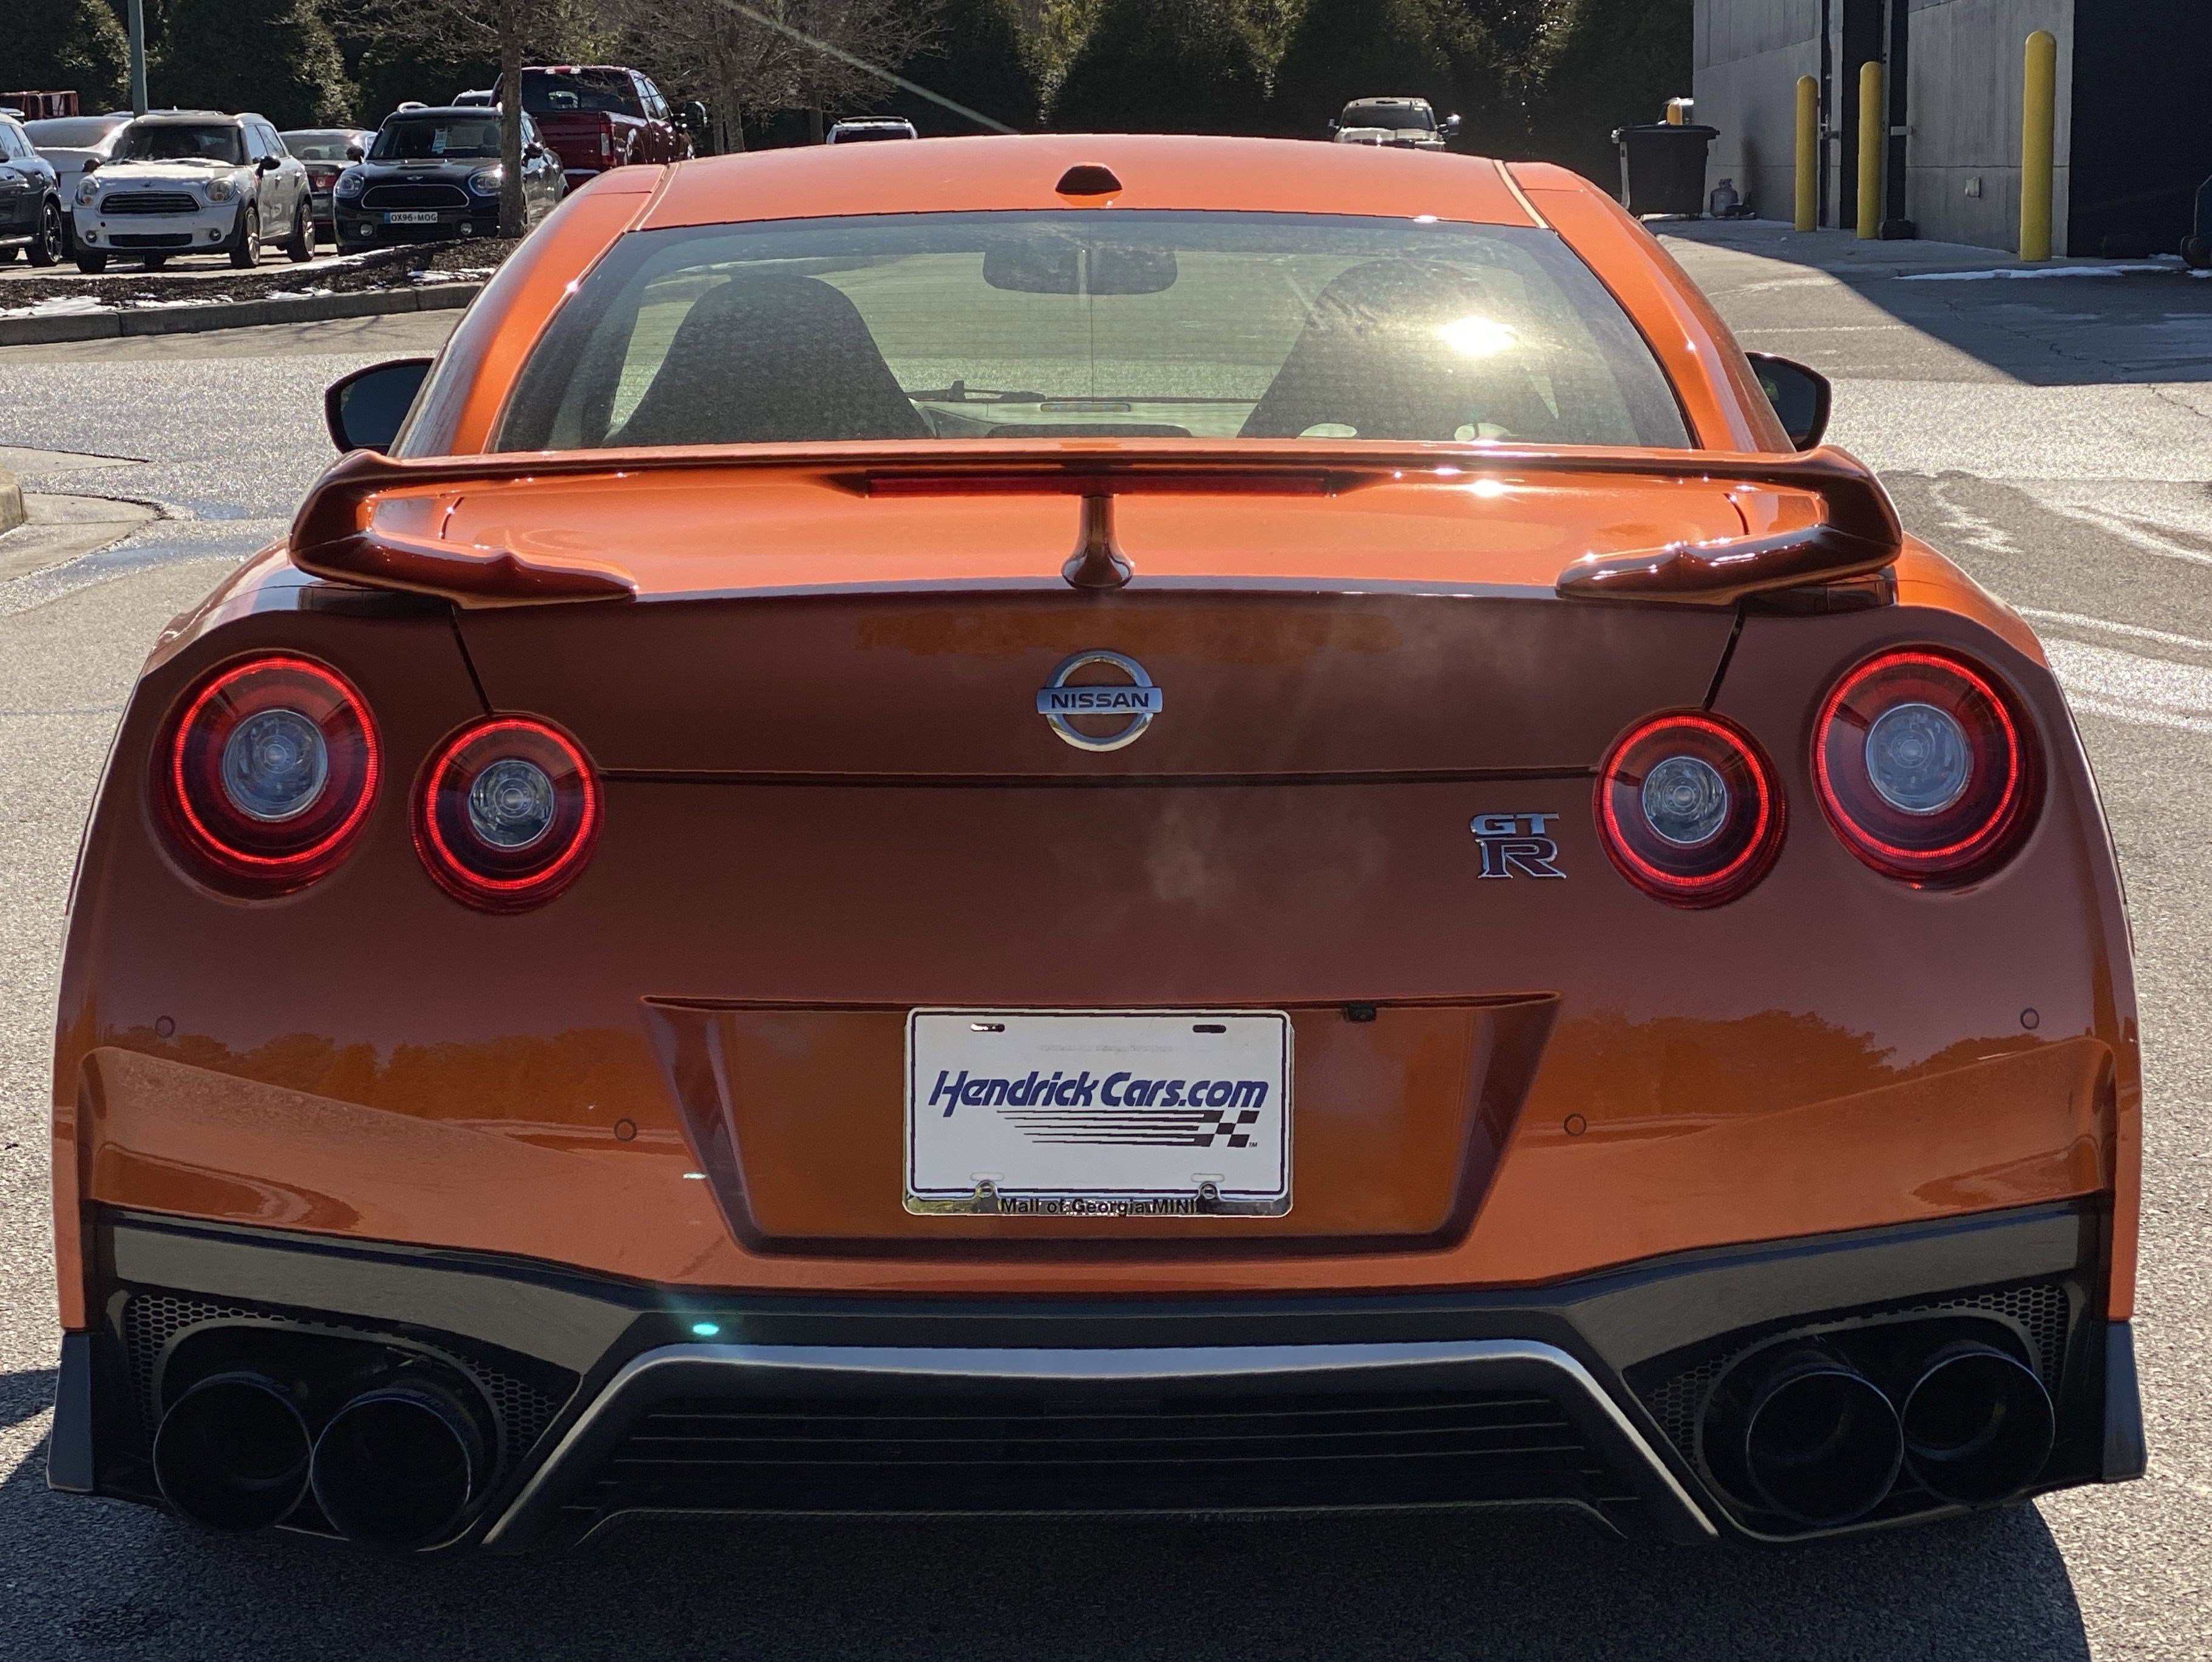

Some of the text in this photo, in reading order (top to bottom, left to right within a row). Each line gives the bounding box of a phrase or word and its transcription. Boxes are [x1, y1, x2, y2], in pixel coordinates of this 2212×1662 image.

[1051, 693, 1149, 709] NISSAN
[1470, 813, 1559, 835] GT
[1475, 837, 1567, 879] R
[1001, 1198, 1195, 1216] Mall of Georgia MINI
